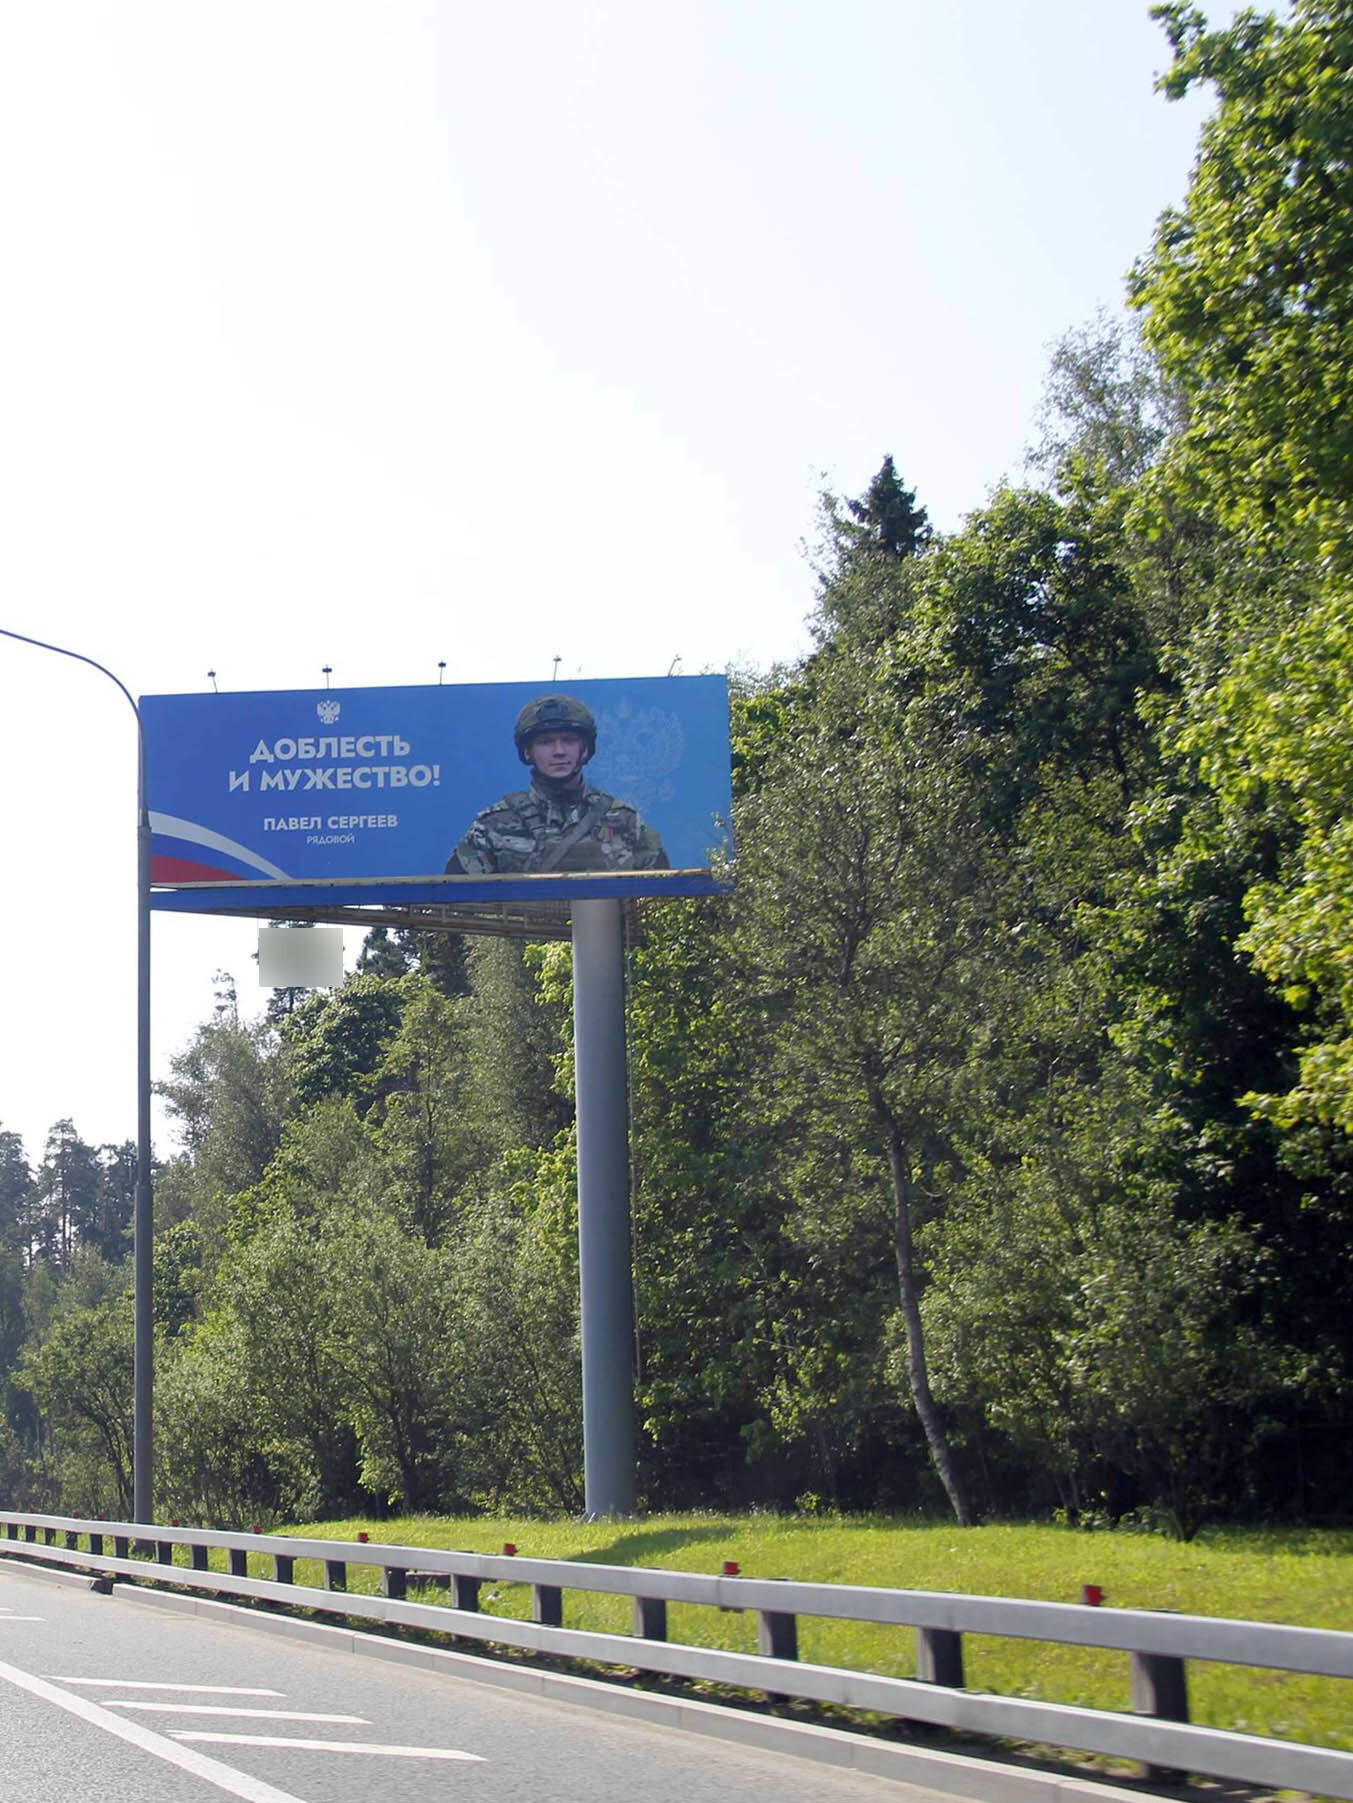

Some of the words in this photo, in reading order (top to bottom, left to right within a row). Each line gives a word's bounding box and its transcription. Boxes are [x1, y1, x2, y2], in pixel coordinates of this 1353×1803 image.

[250, 735, 410, 763] ДОБЛЕСТЬ
[229, 770, 248, 792] И
[260, 765, 440, 791] МУЖЕСТВО!
[263, 816, 322, 831] ПАВЕЛ
[327, 814, 398, 829] СЕРГЕЕВ
[306, 833, 355, 845] РЯДОВОЙ
